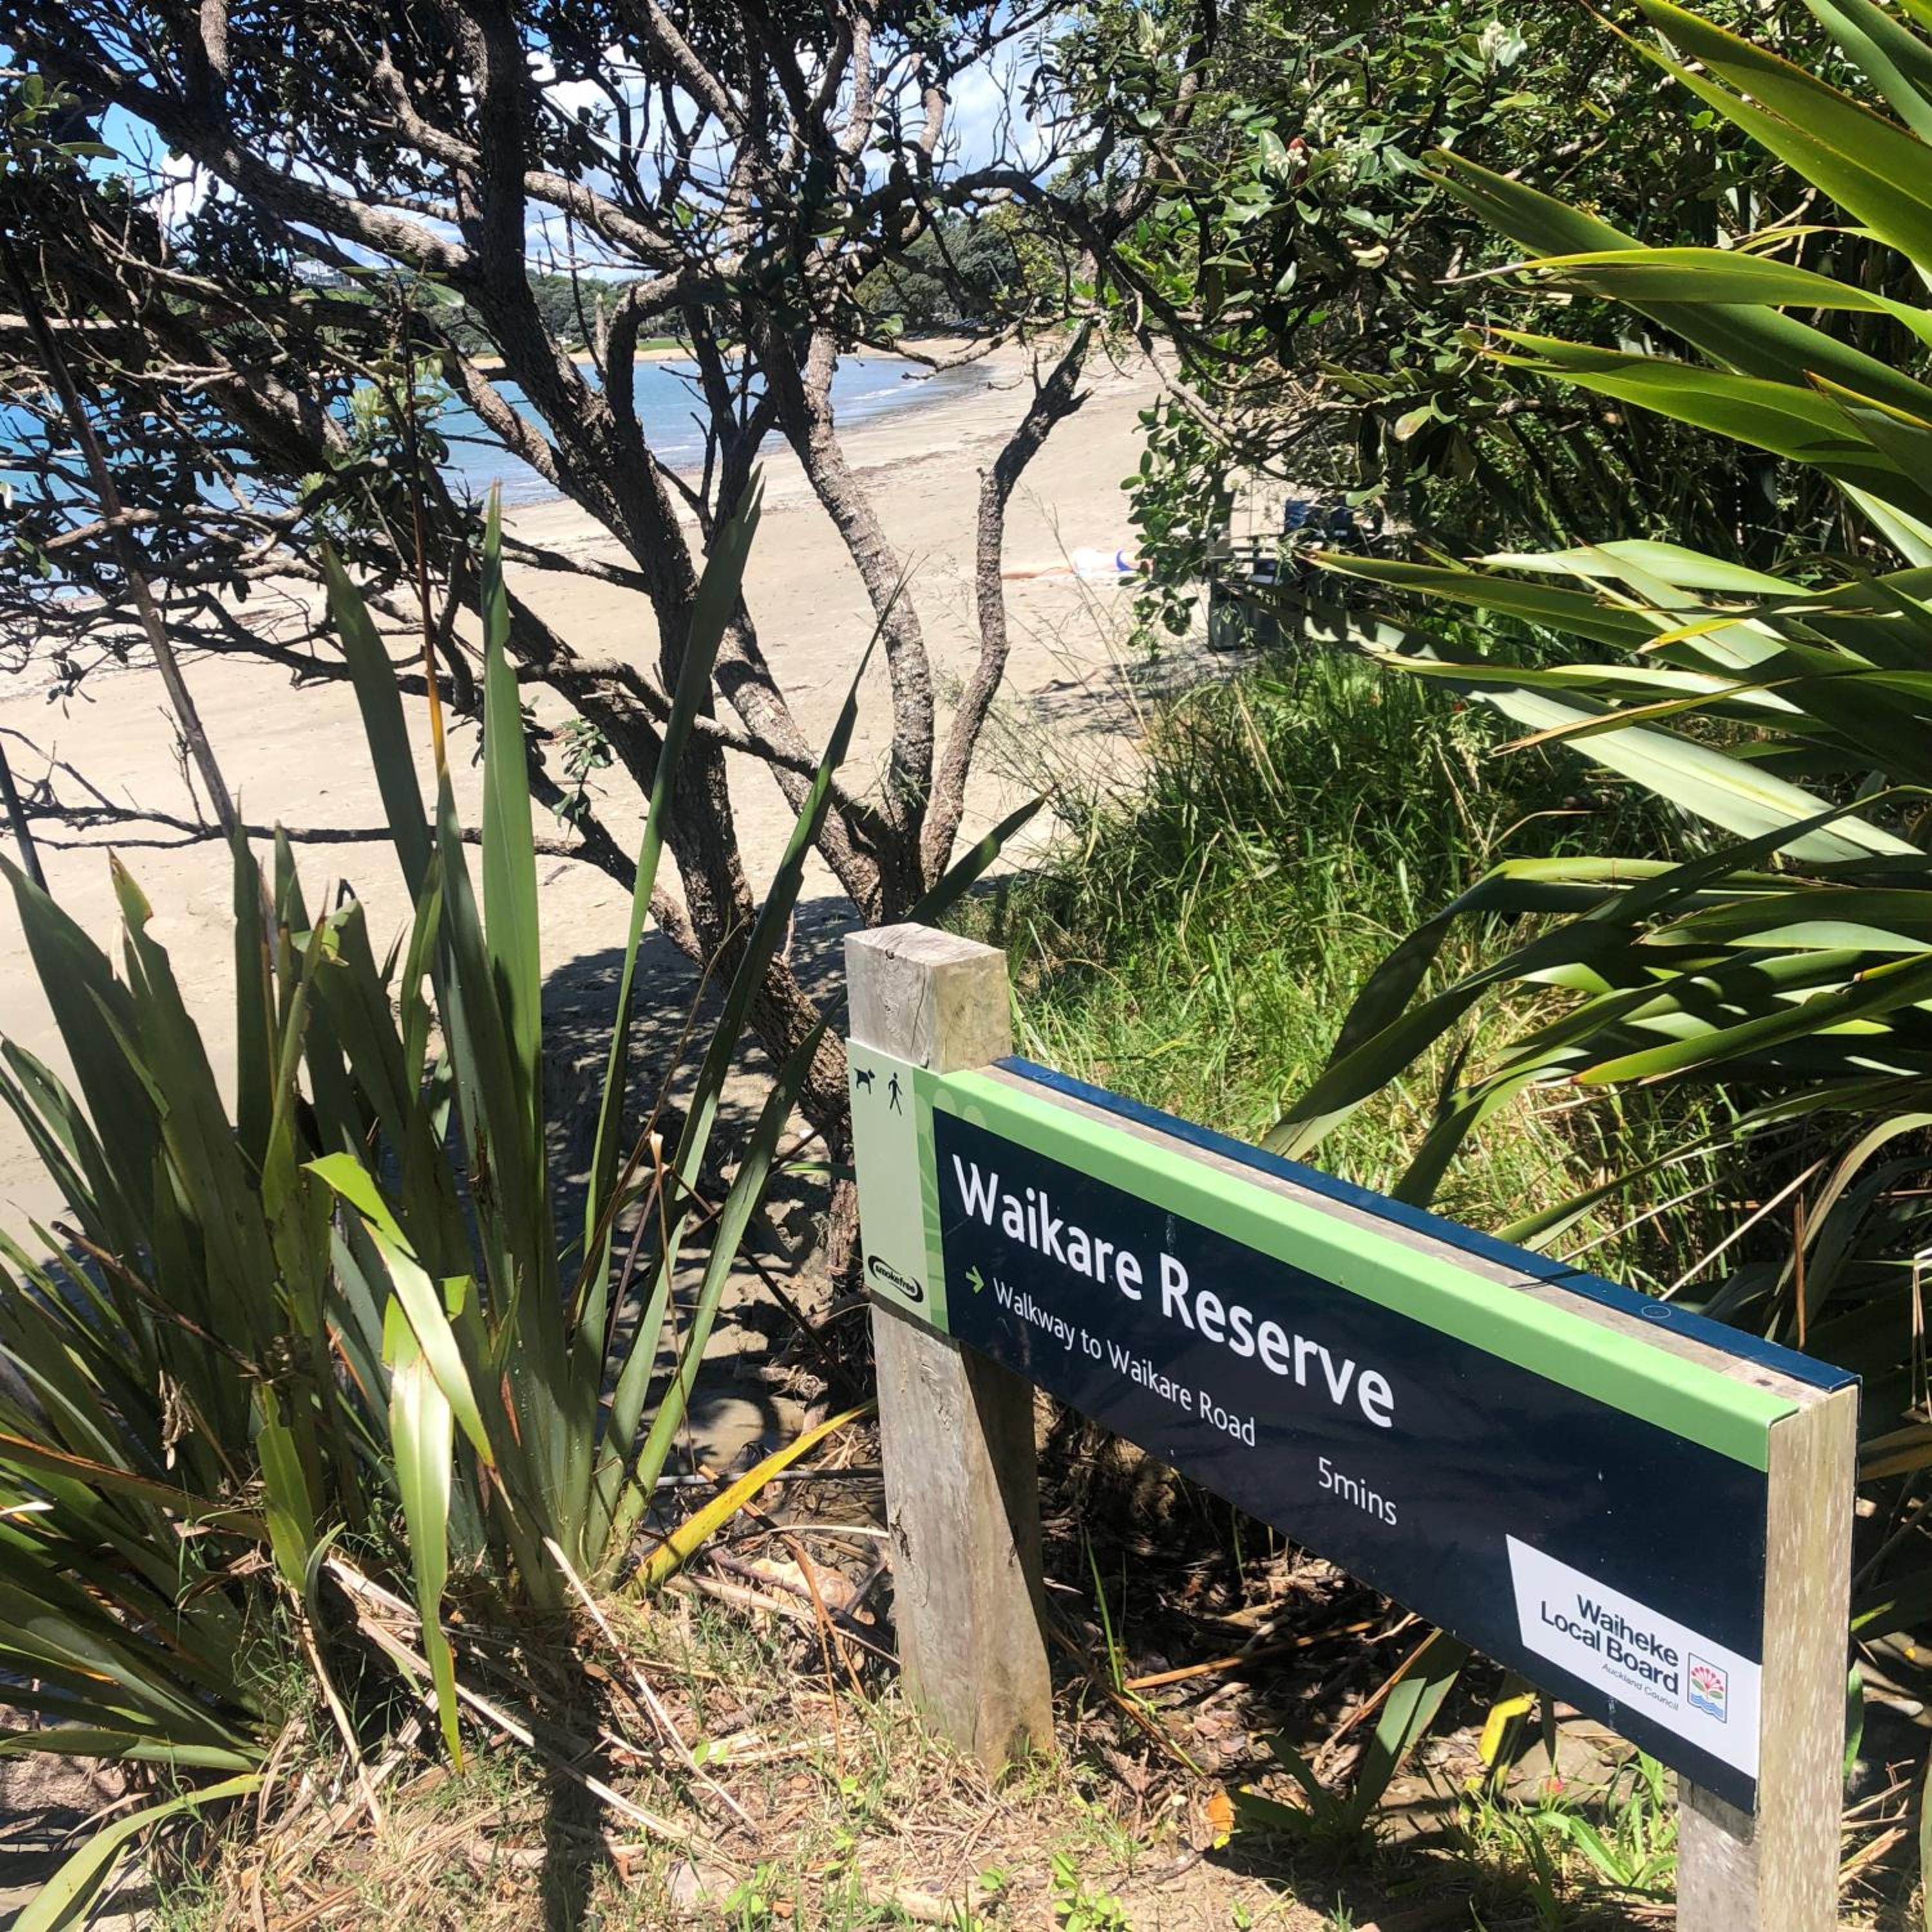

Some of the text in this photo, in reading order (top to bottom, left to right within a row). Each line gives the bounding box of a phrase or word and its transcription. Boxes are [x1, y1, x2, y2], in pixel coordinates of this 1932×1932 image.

[875, 1264, 916, 1294] smokefree
[952, 1153, 1394, 1428] Waikare Reserve
[993, 1276, 1255, 1447] Walkway to Waikare Road
[1318, 1455, 1397, 1526] 5mins
[1541, 1600, 1679, 1696] Local Board
[1577, 1594, 1679, 1667] Waiheke
[1602, 1663, 1679, 1711] Auckland Council
